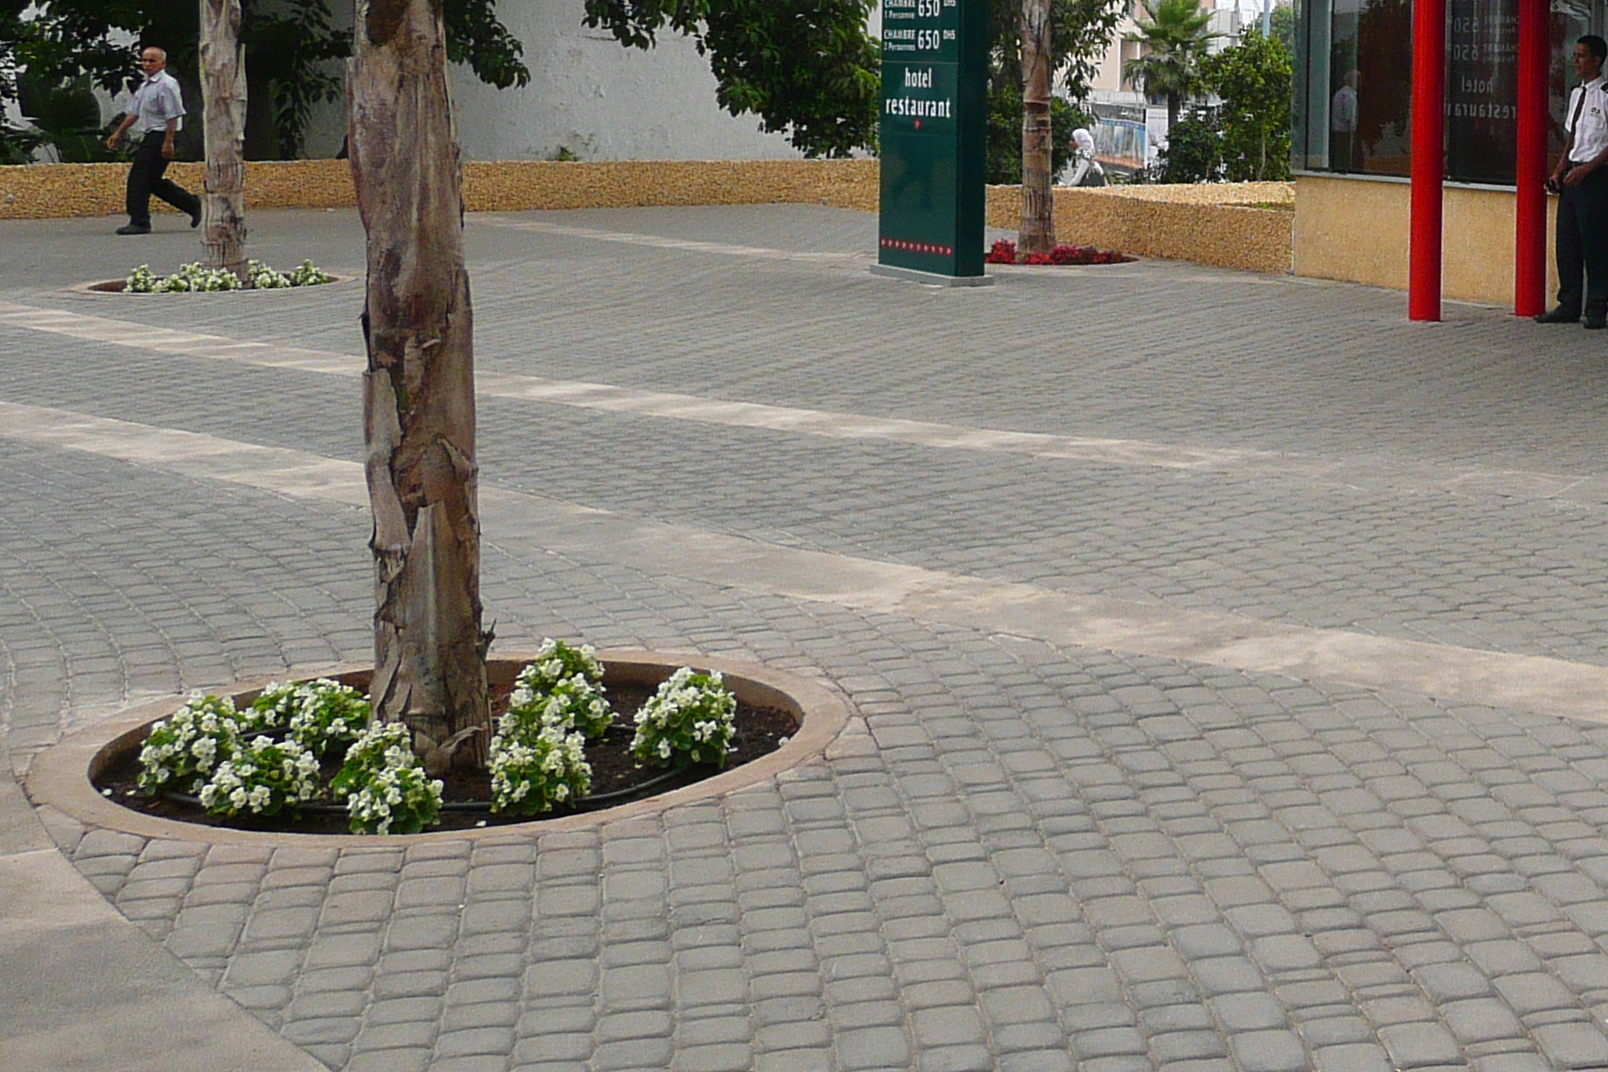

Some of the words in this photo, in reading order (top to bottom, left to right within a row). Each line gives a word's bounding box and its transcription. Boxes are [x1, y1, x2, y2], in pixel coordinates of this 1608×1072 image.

[883, 29, 916, 40] CHAMBRE
[917, 29, 940, 50] 650
[905, 67, 932, 88] hotel
[885, 96, 951, 118] restaurant
